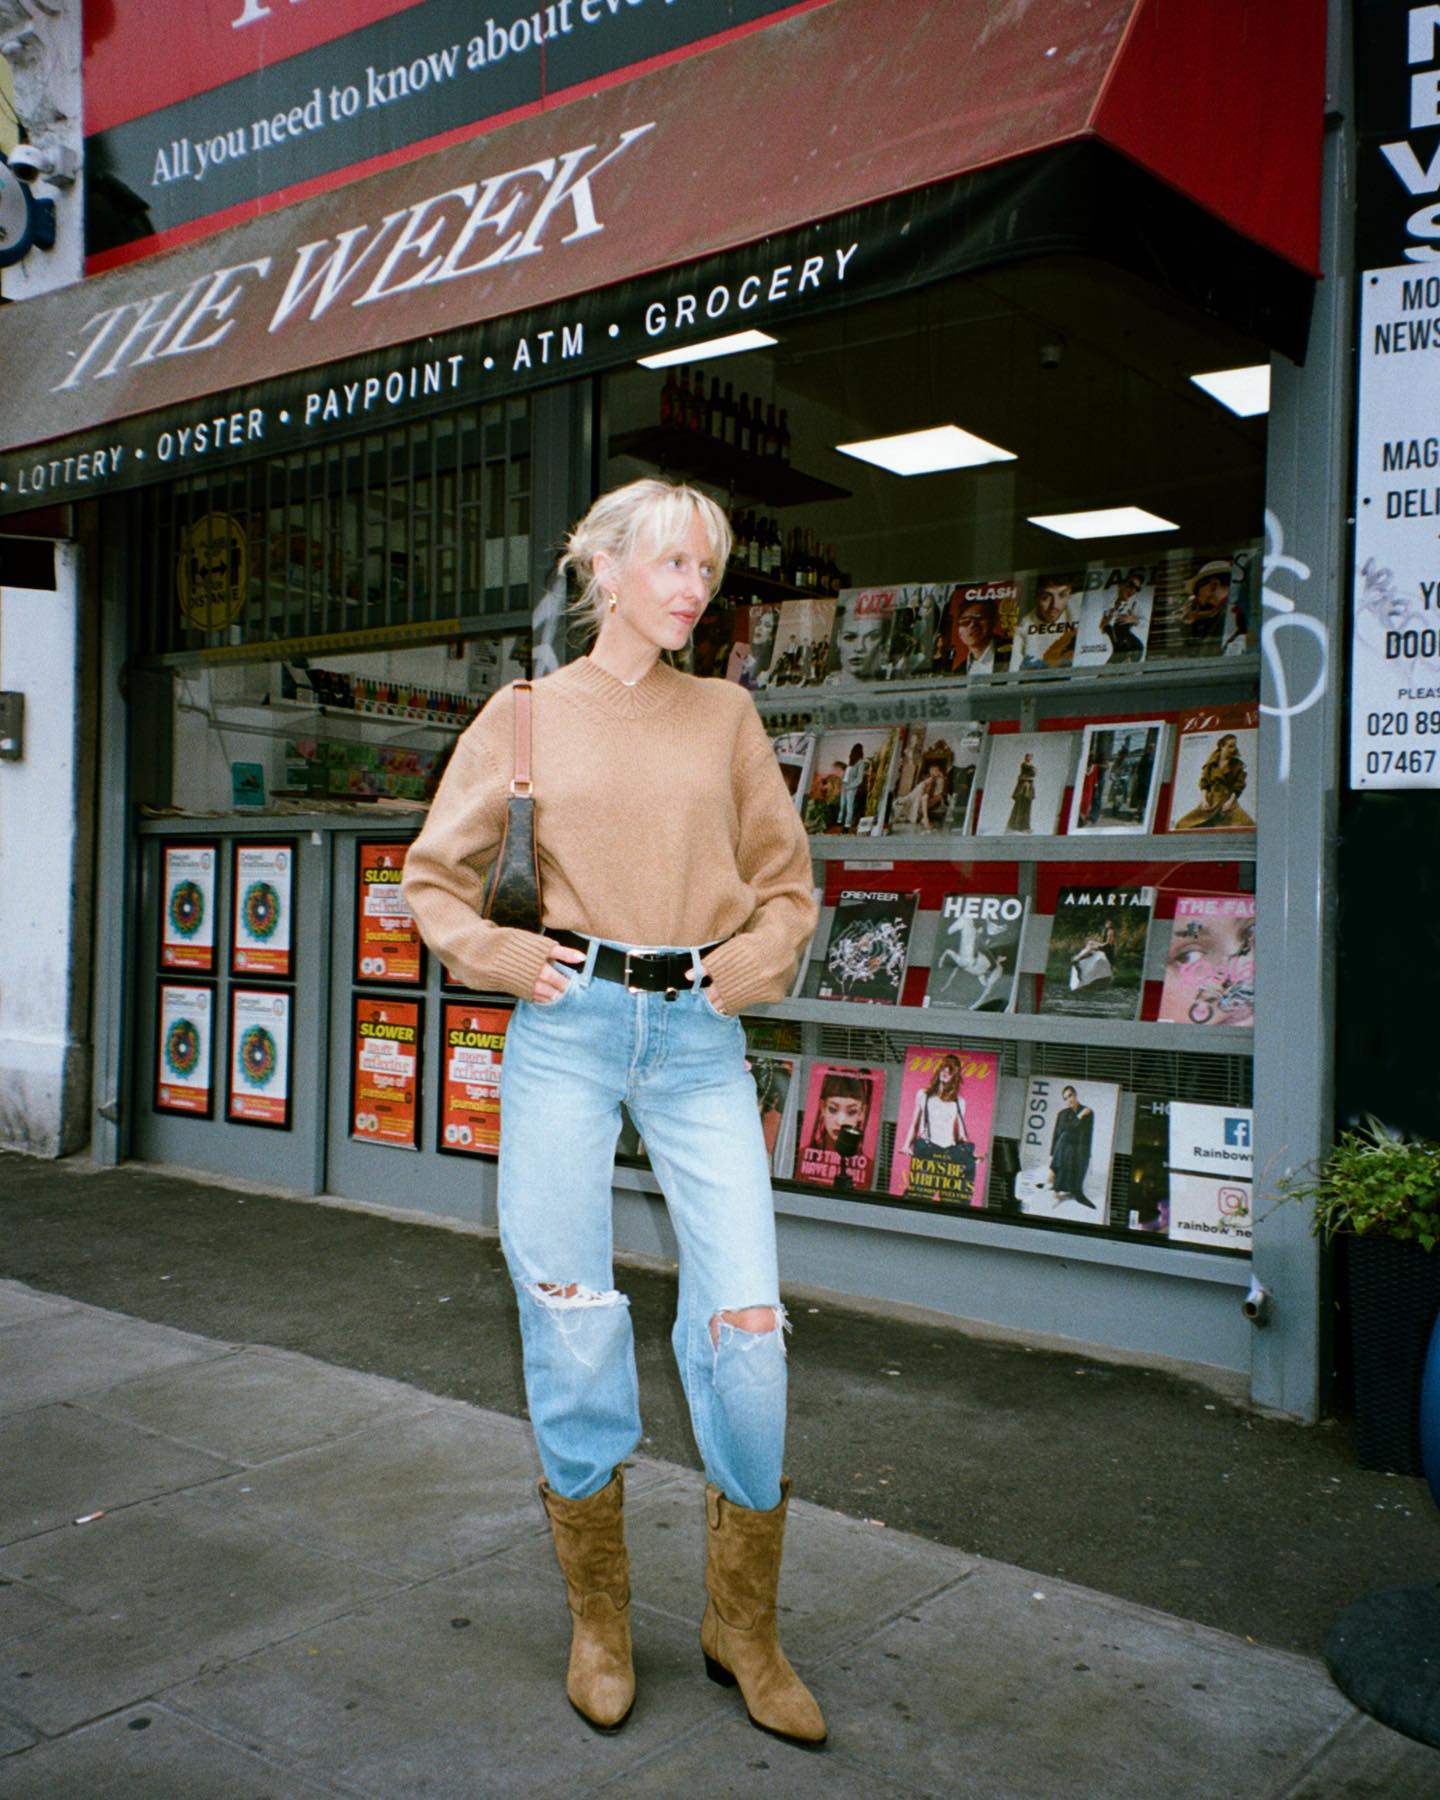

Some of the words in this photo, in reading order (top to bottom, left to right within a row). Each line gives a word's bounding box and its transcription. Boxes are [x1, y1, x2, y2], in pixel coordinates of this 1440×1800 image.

[152, 138, 190, 186] All
[194, 128, 247, 181] you
[251, 88, 324, 150] need
[329, 86, 361, 121] to
[365, 45, 460, 107] know
[466, 0, 574, 70] about
[51, 256, 271, 392] THE
[269, 122, 656, 333] WEEK
[18, 445, 122, 494] LOTTERY
[157, 408, 264, 462] OYSTER
[305, 355, 463, 426] PAYPOINT
[512, 323, 584, 371] ATM
[645, 243, 858, 336] GROCERY
[1383, 437, 1439, 471] MAG
[965, 587, 1018, 601] CLASH
[1386, 629, 1440, 659] DOO
[1368, 712, 1408, 736] 020
[1416, 711, 1440, 735] 89
[1367, 750, 1436, 774] 07467
[364, 869, 402, 883] SLOW
[943, 896, 1023, 920] HERO
[1180, 900, 1218, 914] THE
[360, 1023, 414, 1041] SLOWER
[1026, 1081, 1050, 1147] POSH
[1193, 1146, 1254, 1162] Rainbow
